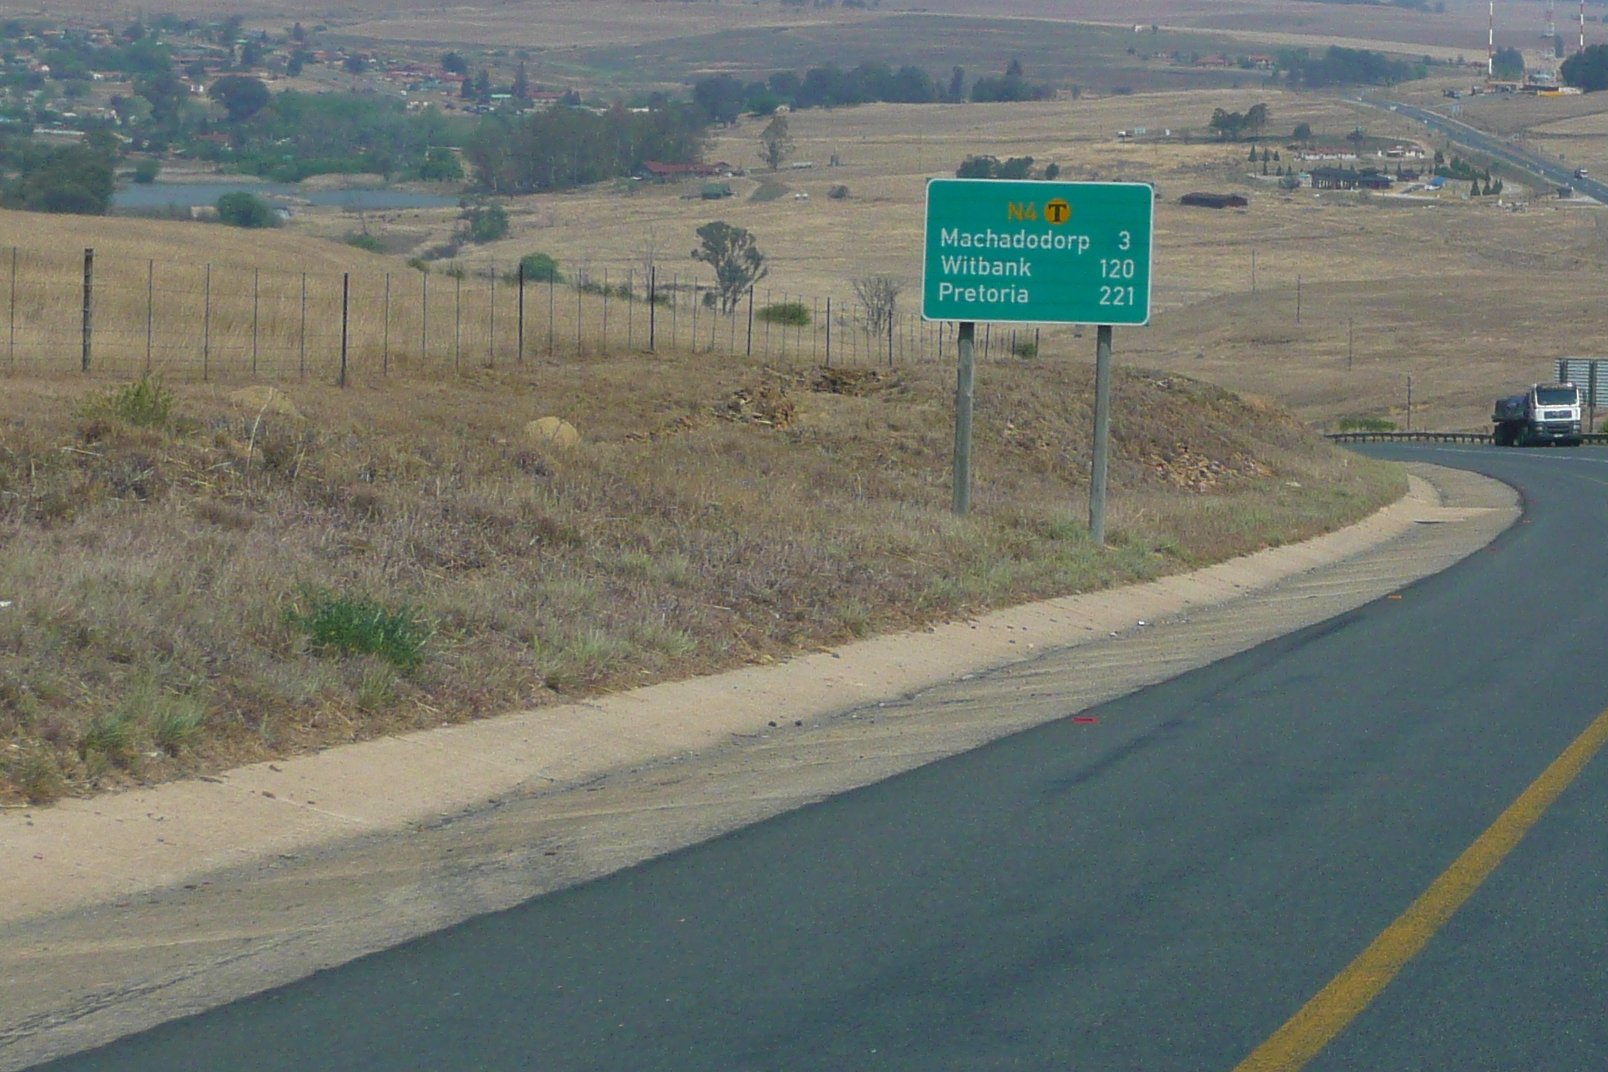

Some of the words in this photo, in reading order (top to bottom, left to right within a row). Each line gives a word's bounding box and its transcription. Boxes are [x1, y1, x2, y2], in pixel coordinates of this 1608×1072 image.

[1008, 201, 1038, 221] N4
[1048, 203, 1067, 222] T
[941, 227, 1090, 255] Machadodorp
[1118, 231, 1131, 250] 3
[941, 255, 1031, 277] Witbank
[1100, 259, 1135, 279] 120
[938, 282, 1029, 303] Pretoria
[1099, 286, 1134, 306] 221
